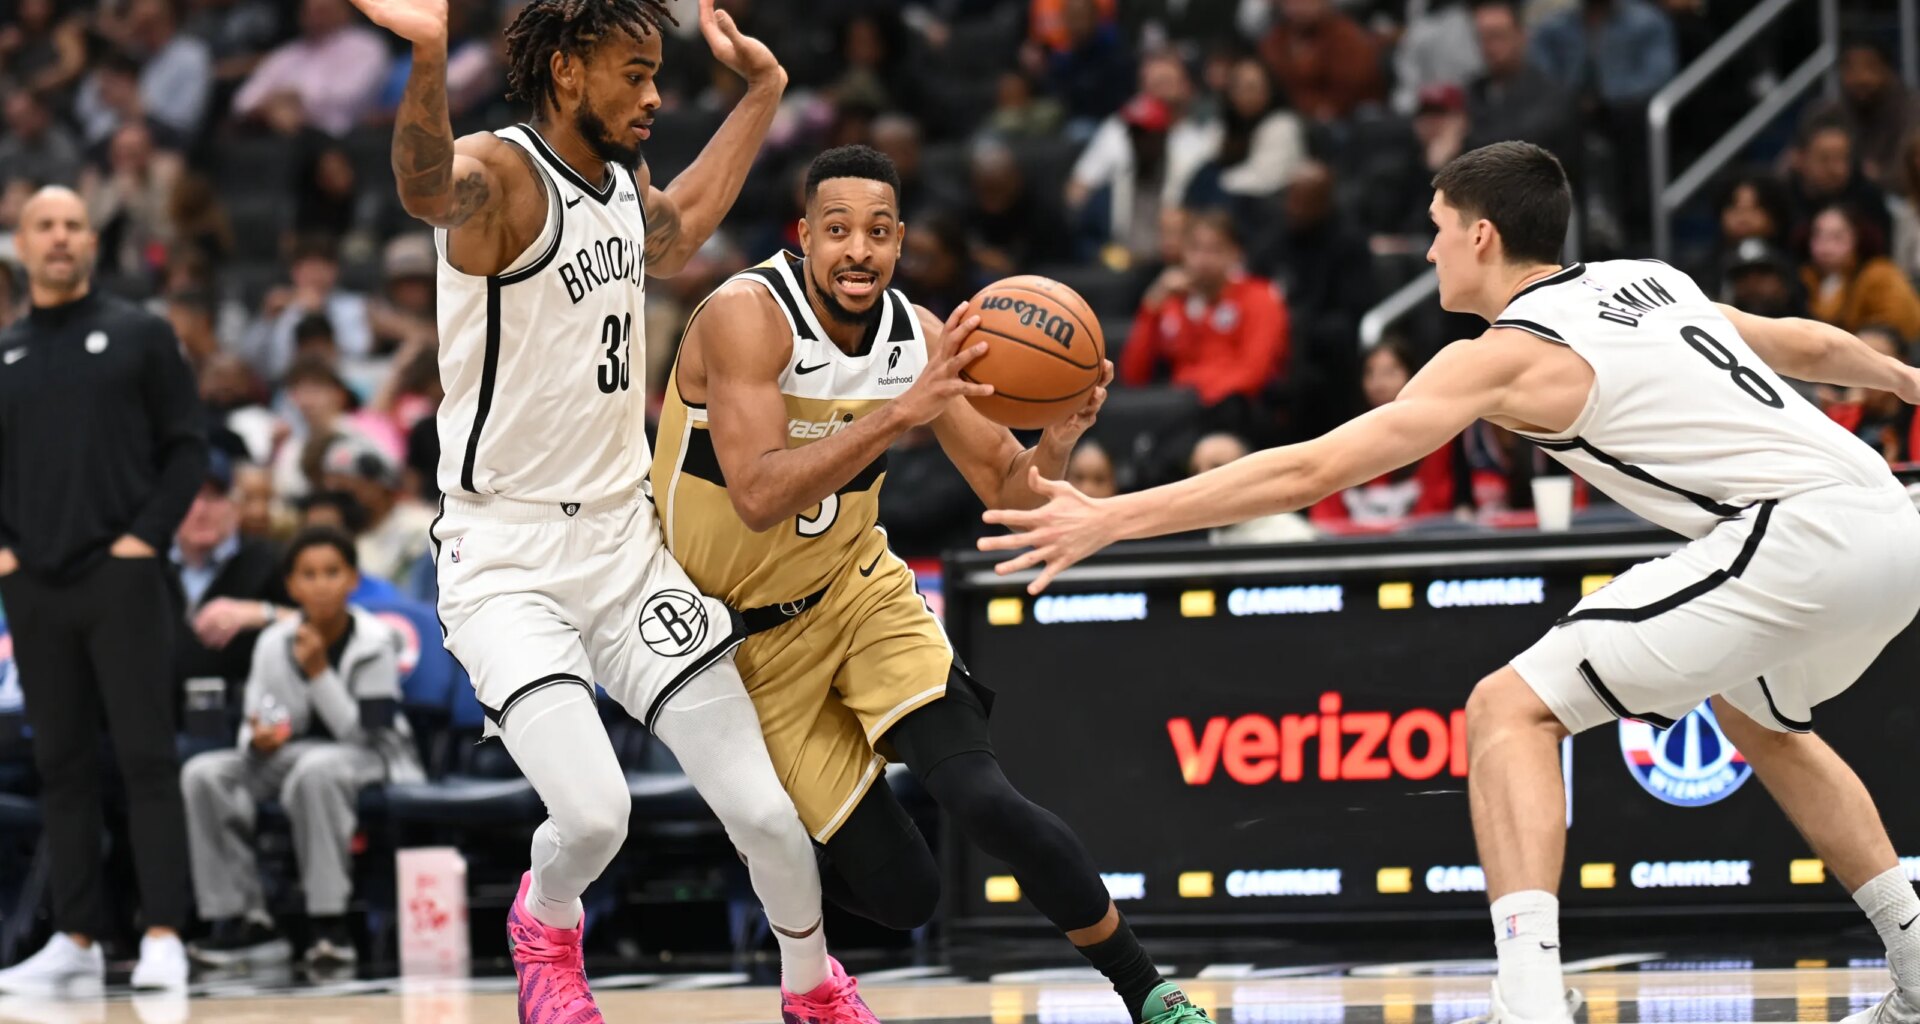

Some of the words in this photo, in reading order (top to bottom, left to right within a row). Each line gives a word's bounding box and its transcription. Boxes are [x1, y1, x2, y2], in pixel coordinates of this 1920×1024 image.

[558, 237, 645, 304] BROOLY
[597, 312, 631, 393] 33
[981, 296, 1075, 350] Wilson
[878, 375, 913, 385] Robinhood
[1680, 325, 1785, 409] 8
